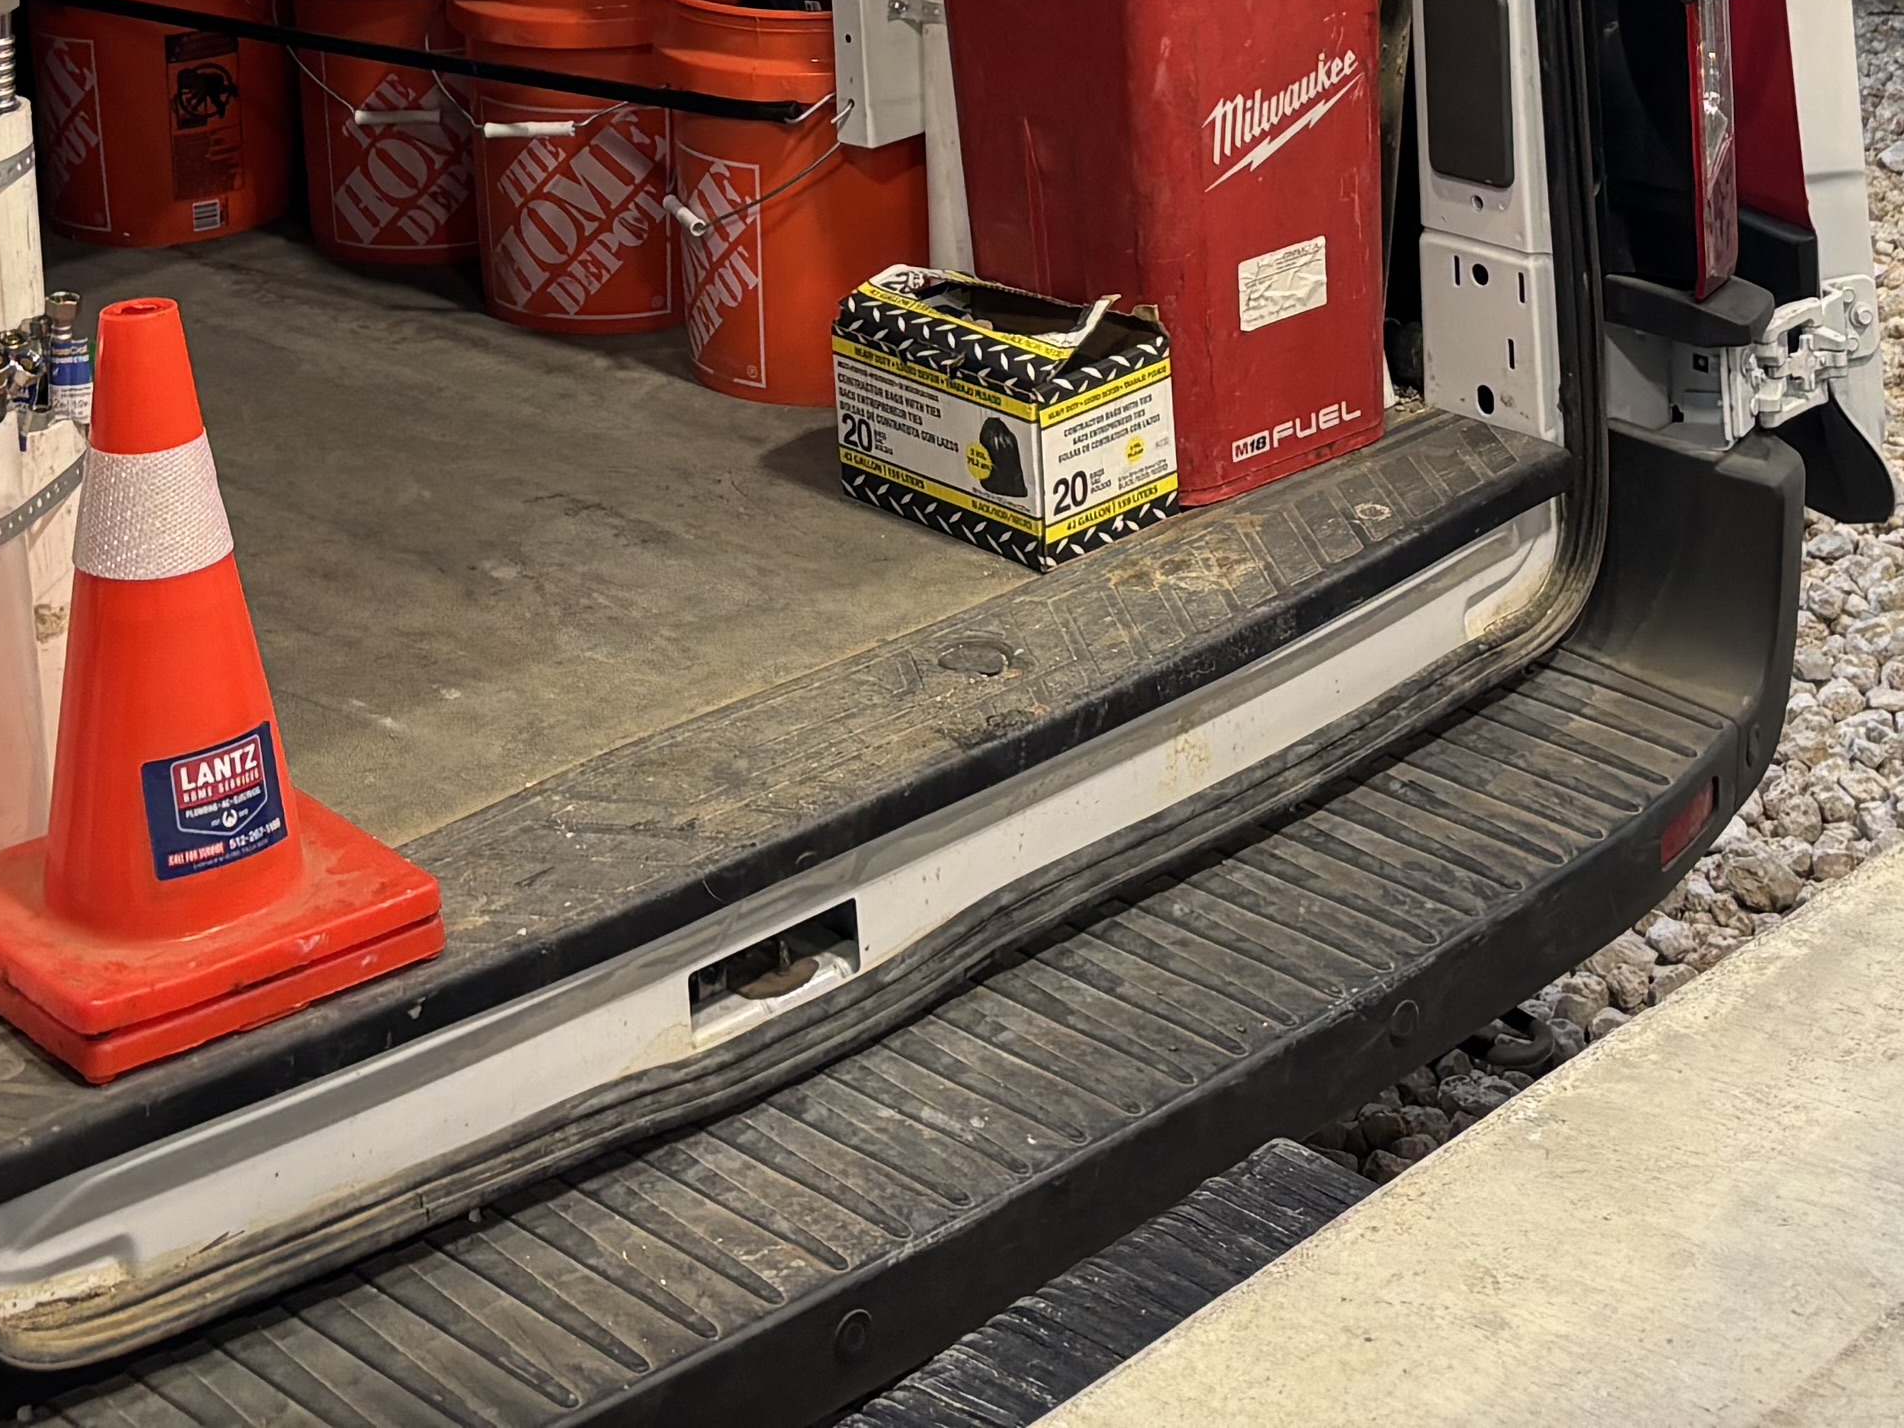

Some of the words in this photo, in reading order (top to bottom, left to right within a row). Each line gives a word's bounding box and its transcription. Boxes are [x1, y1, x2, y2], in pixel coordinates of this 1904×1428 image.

[1201, 49, 1359, 166] Milwaukee
[498, 136, 567, 207] THE
[496, 111, 669, 308] HOME
[547, 183, 668, 316] DEPOT
[841, 412, 873, 453] 20
[1234, 435, 1269, 459] M18
[1273, 400, 1362, 448] FUEL
[1052, 470, 1088, 517] 20
[1078, 504, 1112, 527] GALLON
[1132, 484, 1159, 502] LITERS
[179, 742, 258, 791] LANTZ
